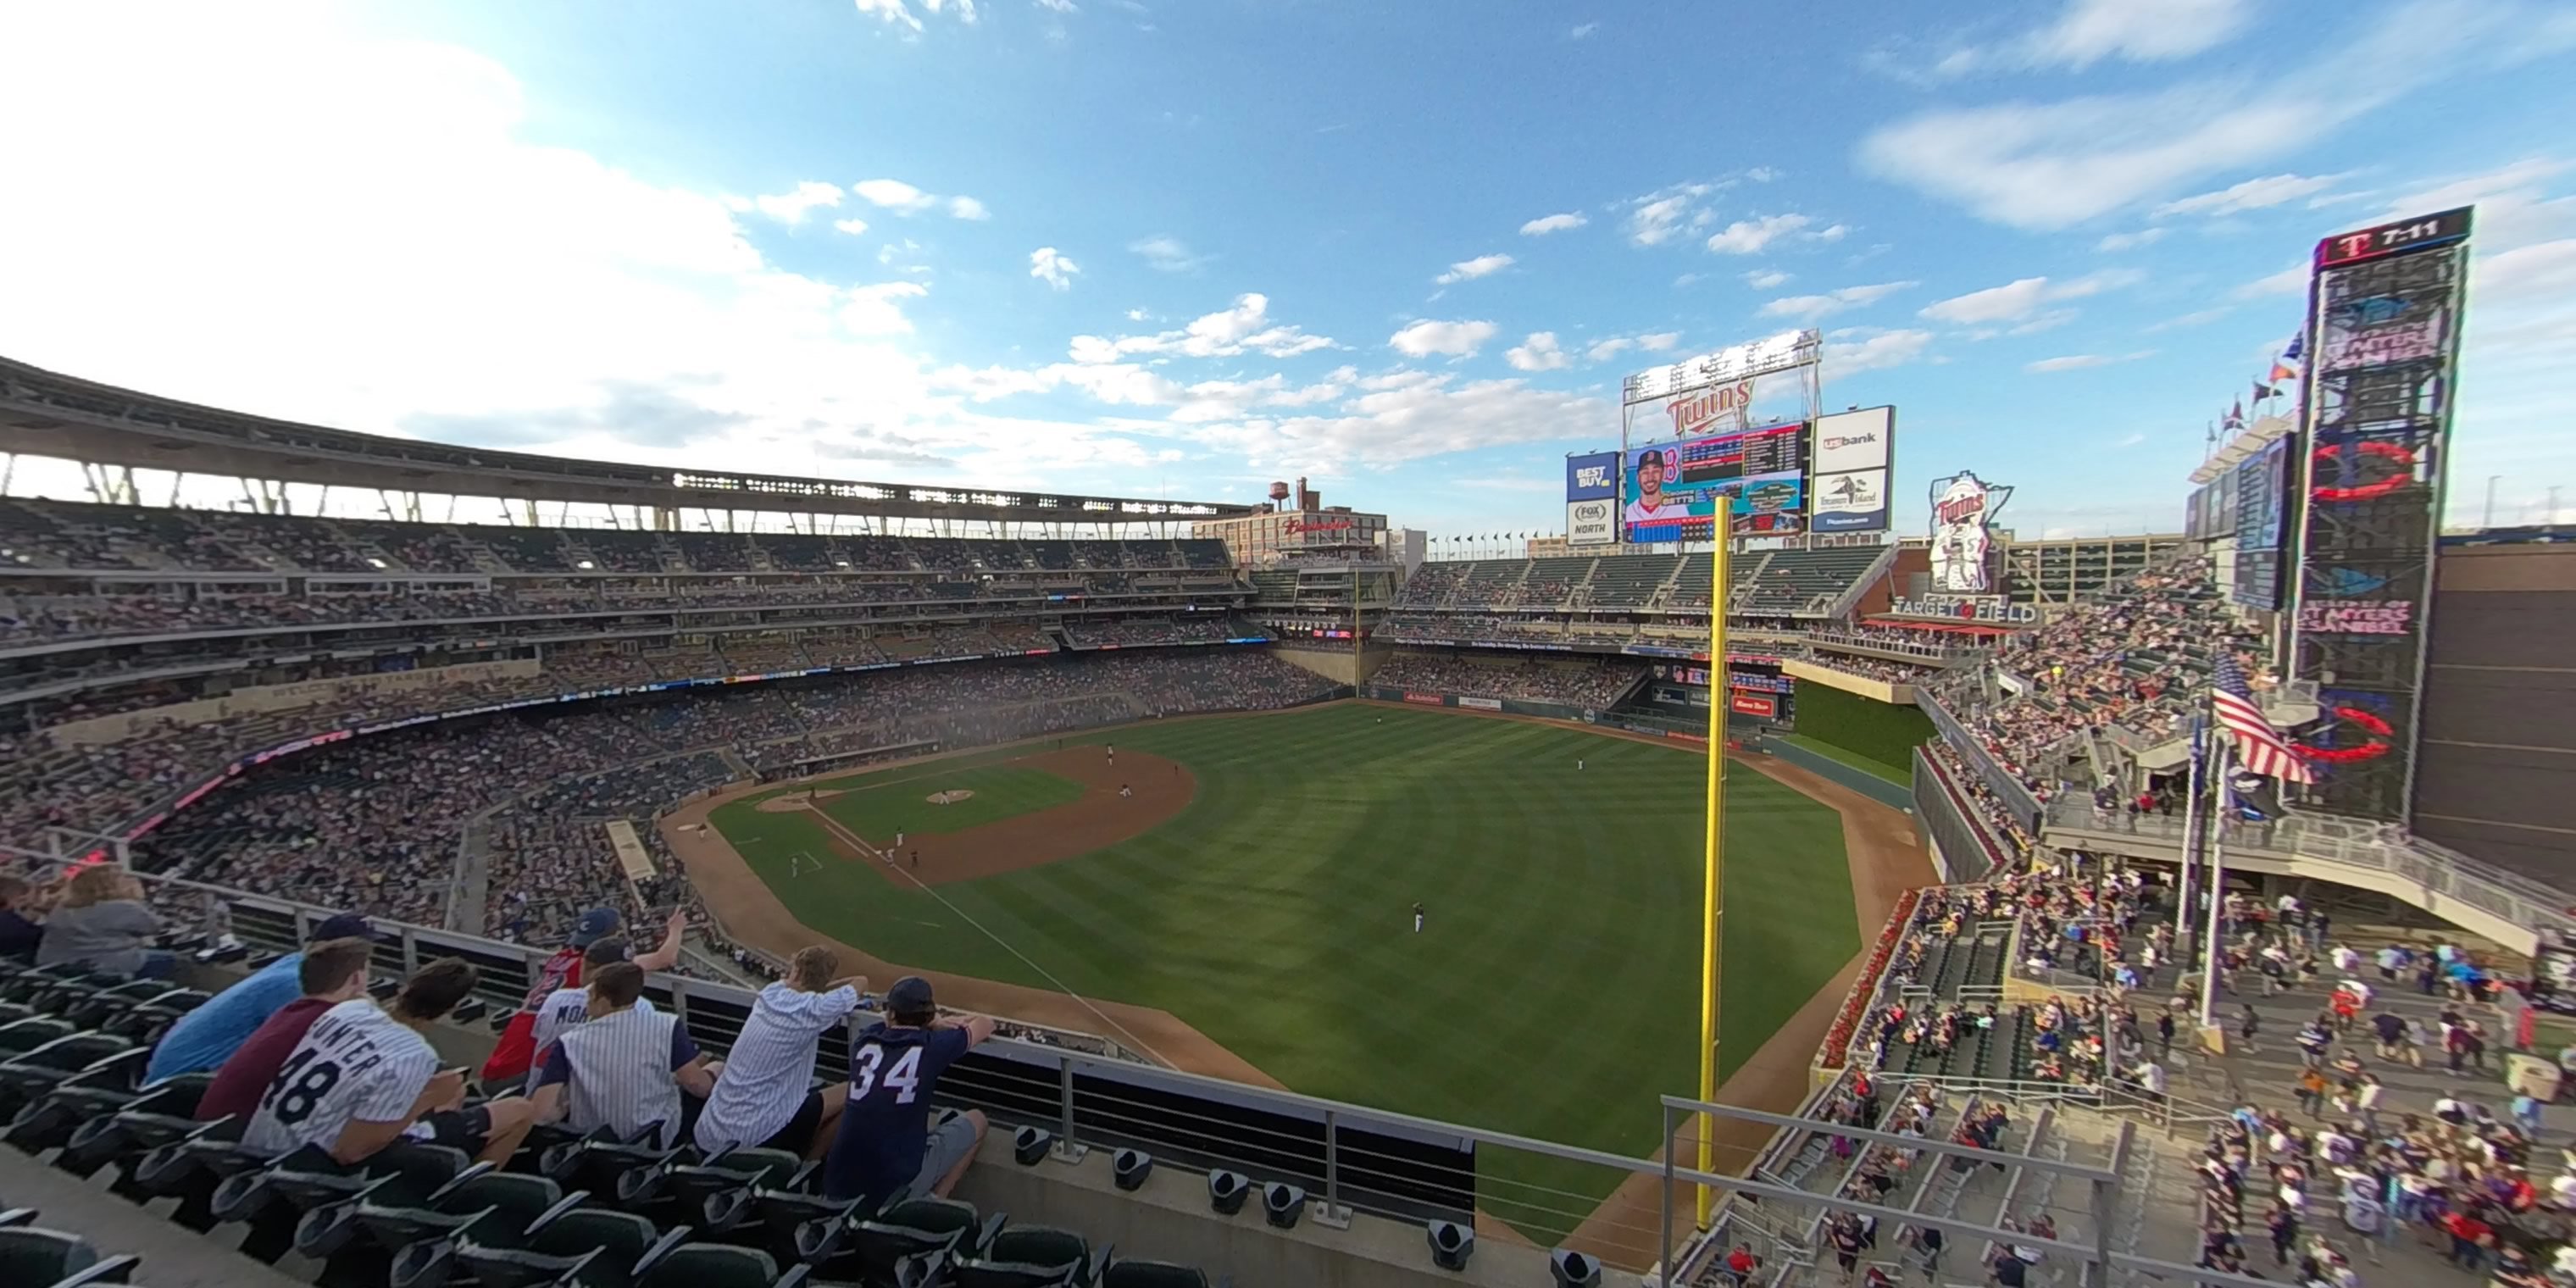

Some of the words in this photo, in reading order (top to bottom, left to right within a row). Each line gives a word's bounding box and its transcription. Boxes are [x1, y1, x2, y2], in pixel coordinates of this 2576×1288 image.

[2382, 219, 2439, 246] 7:11
[1667, 381, 1751, 436] Twins
[1576, 466, 1606, 479] BEST
[1579, 477, 1602, 488] BUY
[1581, 507, 1600, 515] FOX
[1936, 492, 1985, 526] Twins
[1575, 524, 1607, 535] NORTH
[1895, 599, 1957, 618] TARGET
[1975, 602, 2036, 625] FIELD
[848, 1043, 924, 1104] 34
